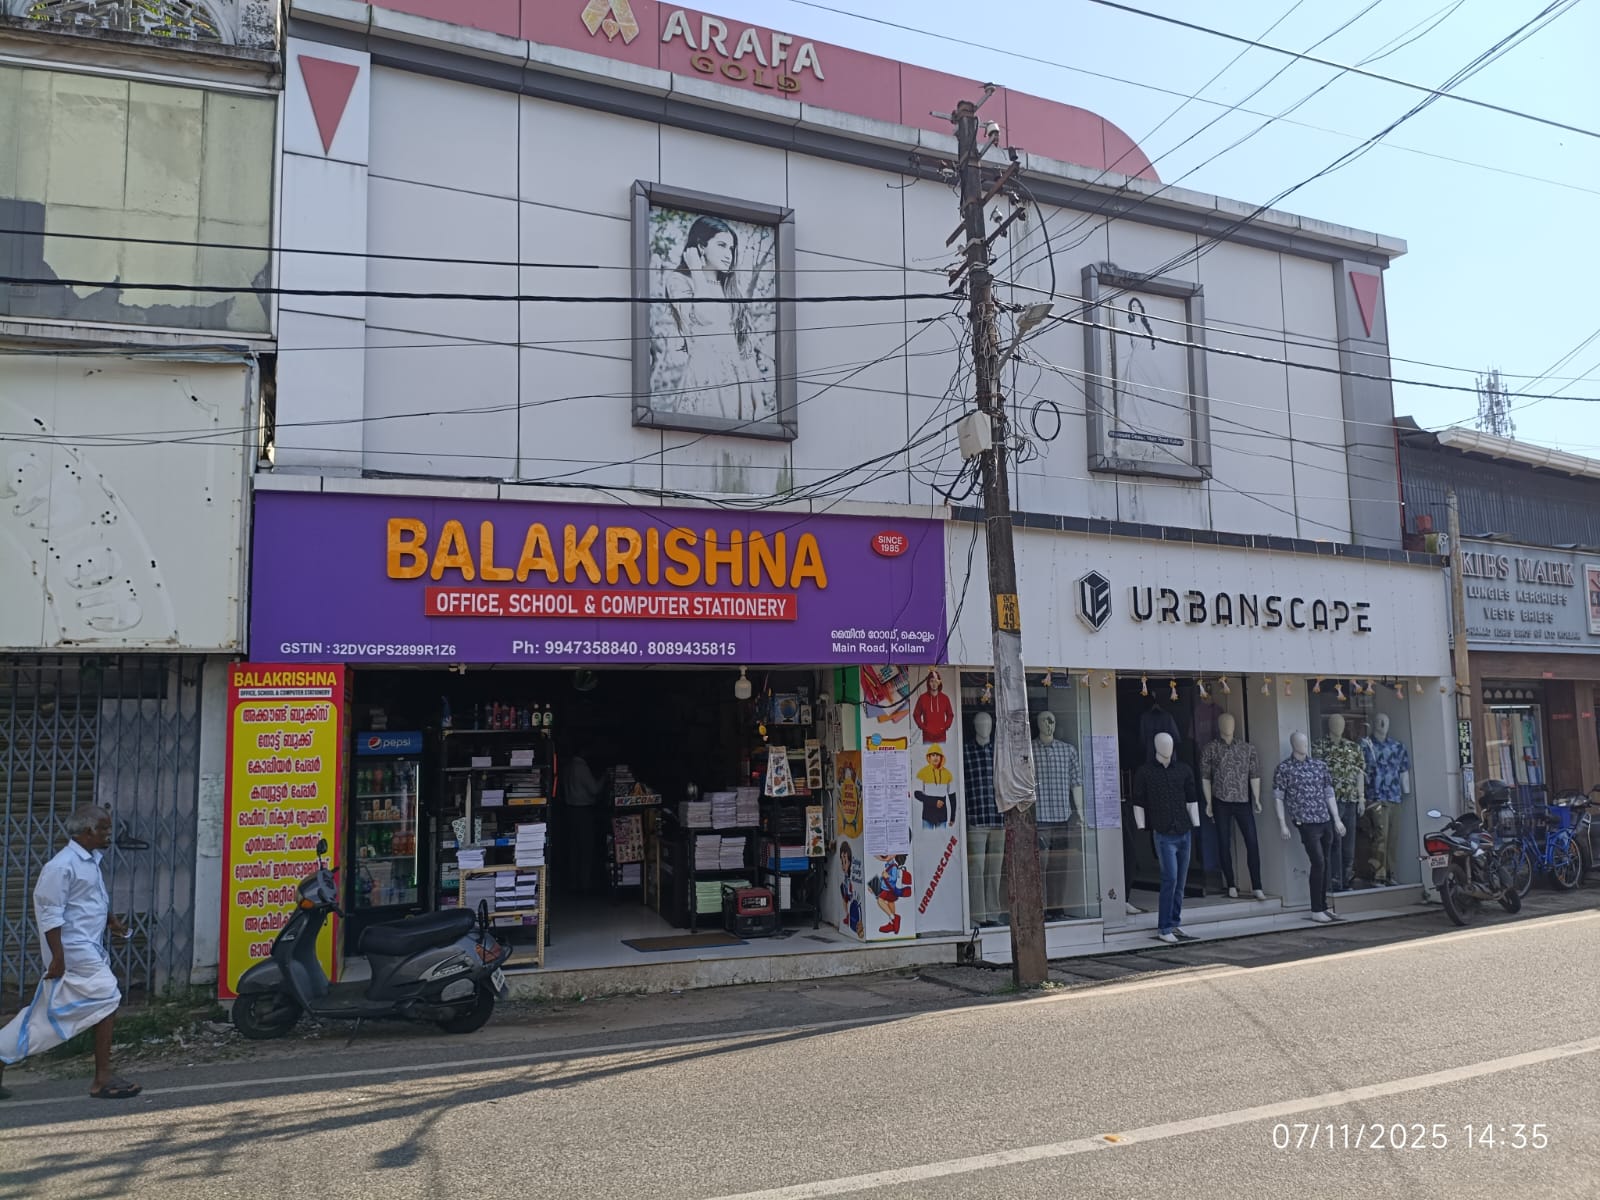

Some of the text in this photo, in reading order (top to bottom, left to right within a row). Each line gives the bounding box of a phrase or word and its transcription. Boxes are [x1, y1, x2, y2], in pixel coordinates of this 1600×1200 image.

[662, 10, 824, 80] ARAFA
[690, 53, 801, 93] GOLD
[878, 535, 903, 545] SINCE
[881, 544, 899, 552] 1985
[386, 517, 828, 590] BALAKRISHNA
[1461, 551, 1576, 587] KIBS MARK
[1467, 586, 1568, 606] LUNGIES KERCHIEFS
[436, 593, 787, 617] OFFICE, SCHOOL & COMPUTER STATIONERY
[1129, 585, 1372, 634] URBANSCAPE
[1484, 607, 1516, 621] VESTS
[831, 628, 866, 640] മെയിൻ
[901, 631, 935, 643] കൊല്ലം
[280, 642, 323, 655] GSTIN
[512, 640, 540, 655] Ph:
[647, 641, 736, 656] 8089435815
[832, 643, 926, 655] Main Road, Kollam
[233, 671, 337, 687] BALAKRISHNA
[382, 737, 411, 749] pepsi
[917, 835, 959, 915] URBANSCAPE
